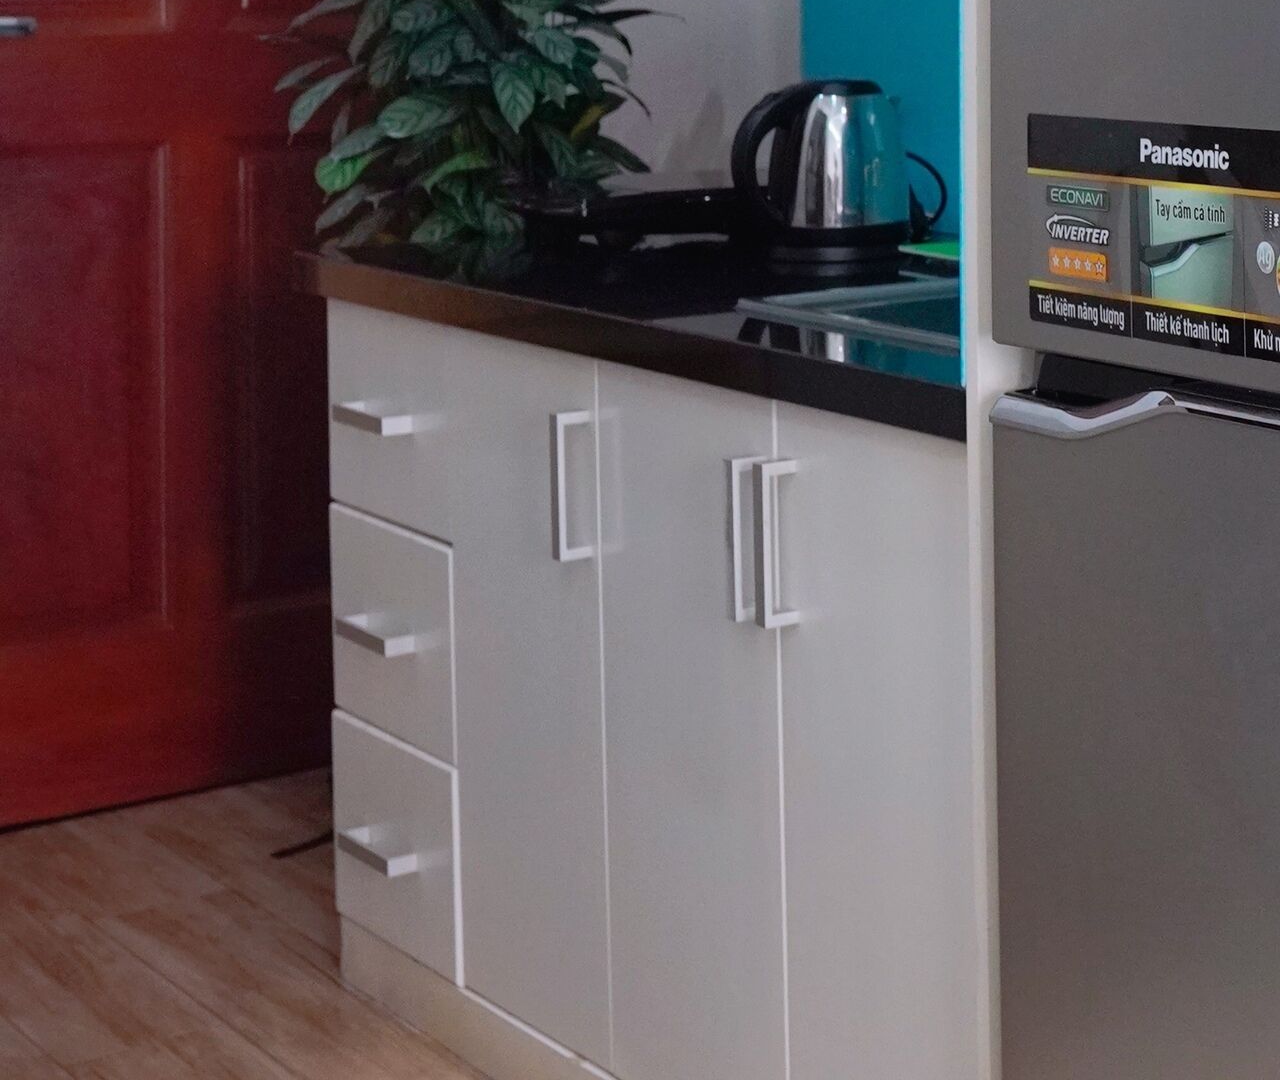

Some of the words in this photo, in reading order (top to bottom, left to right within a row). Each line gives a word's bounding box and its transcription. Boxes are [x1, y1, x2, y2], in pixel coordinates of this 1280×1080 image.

[1140, 137, 1230, 171] Panasonic
[1050, 188, 1104, 207] ECONAVI
[1155, 199, 1171, 221] Tay
[1194, 203, 1205, 221] cá
[1051, 220, 1110, 245] INVERTER
[1037, 294, 1054, 314] Tiết
[1055, 297, 1076, 322] kiệm
[1077, 301, 1098, 327] năng
[1099, 304, 1125, 331] lượng
[1145, 311, 1169, 334] Thiết
[1170, 314, 1183, 336] kế
[1183, 317, 1210, 340] thanh
[1211, 322, 1230, 347] lịch
[1254, 327, 1274, 350] Khử
